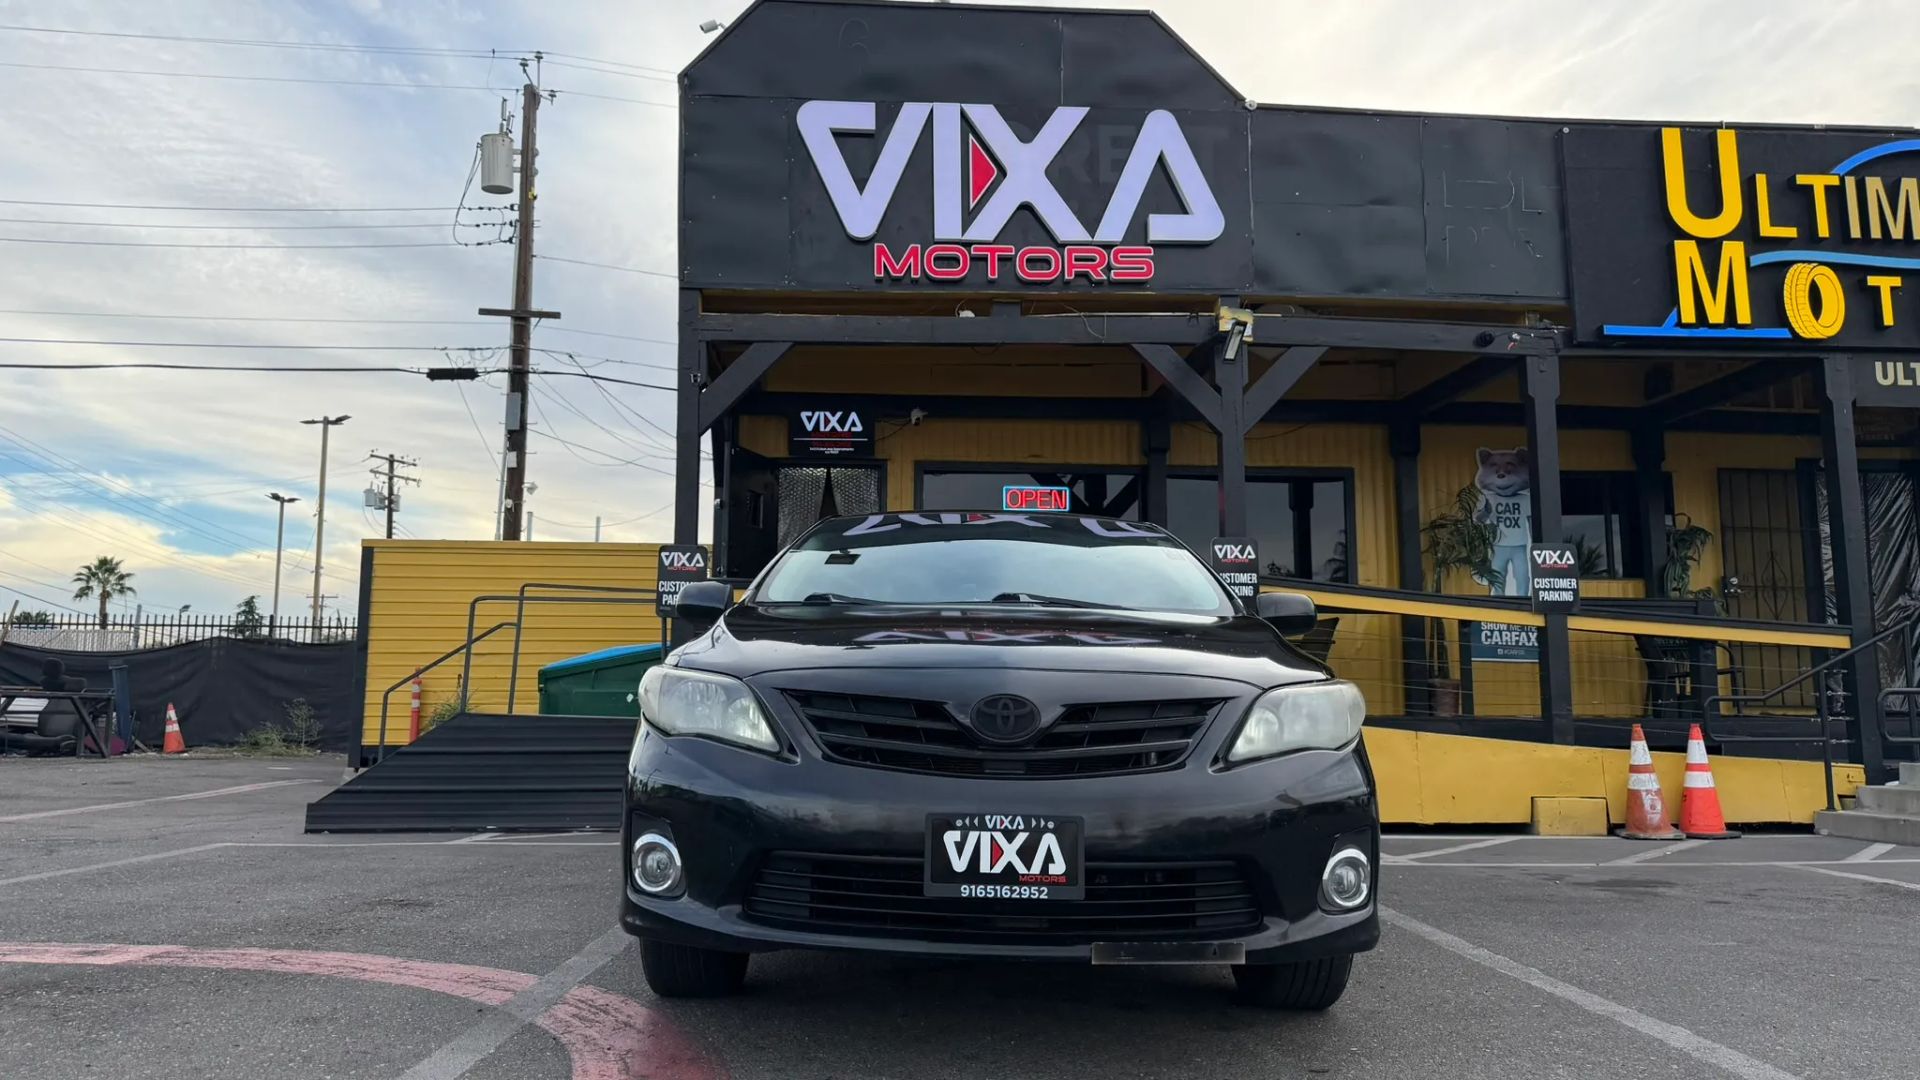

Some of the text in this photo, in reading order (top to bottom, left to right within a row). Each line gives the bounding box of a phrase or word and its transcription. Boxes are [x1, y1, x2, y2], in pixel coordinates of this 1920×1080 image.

[796, 100, 1226, 245] VIXA
[1661, 127, 1920, 241] ULTIM
[874, 243, 1155, 284] MOTORS
[800, 411, 863, 432] VIXA
[1006, 488, 1067, 509] OPEN
[1495, 502, 1521, 516] CAR
[1496, 516, 1521, 528] FOX
[661, 551, 705, 567] VIXA
[1214, 544, 1256, 559] VIXA
[1532, 550, 1575, 565] VIXA
[1220, 572, 1258, 584] USTOMER
[1534, 578, 1577, 589] CUSTOMER
[1539, 590, 1574, 602] PARKING
[1480, 630, 1538, 646] CARFAX
[985, 815, 1024, 830] VIXA
[943, 830, 1066, 875] VIXA
[1019, 875, 1067, 883] MOTORS
[960, 885, 1048, 899] 9165162952
